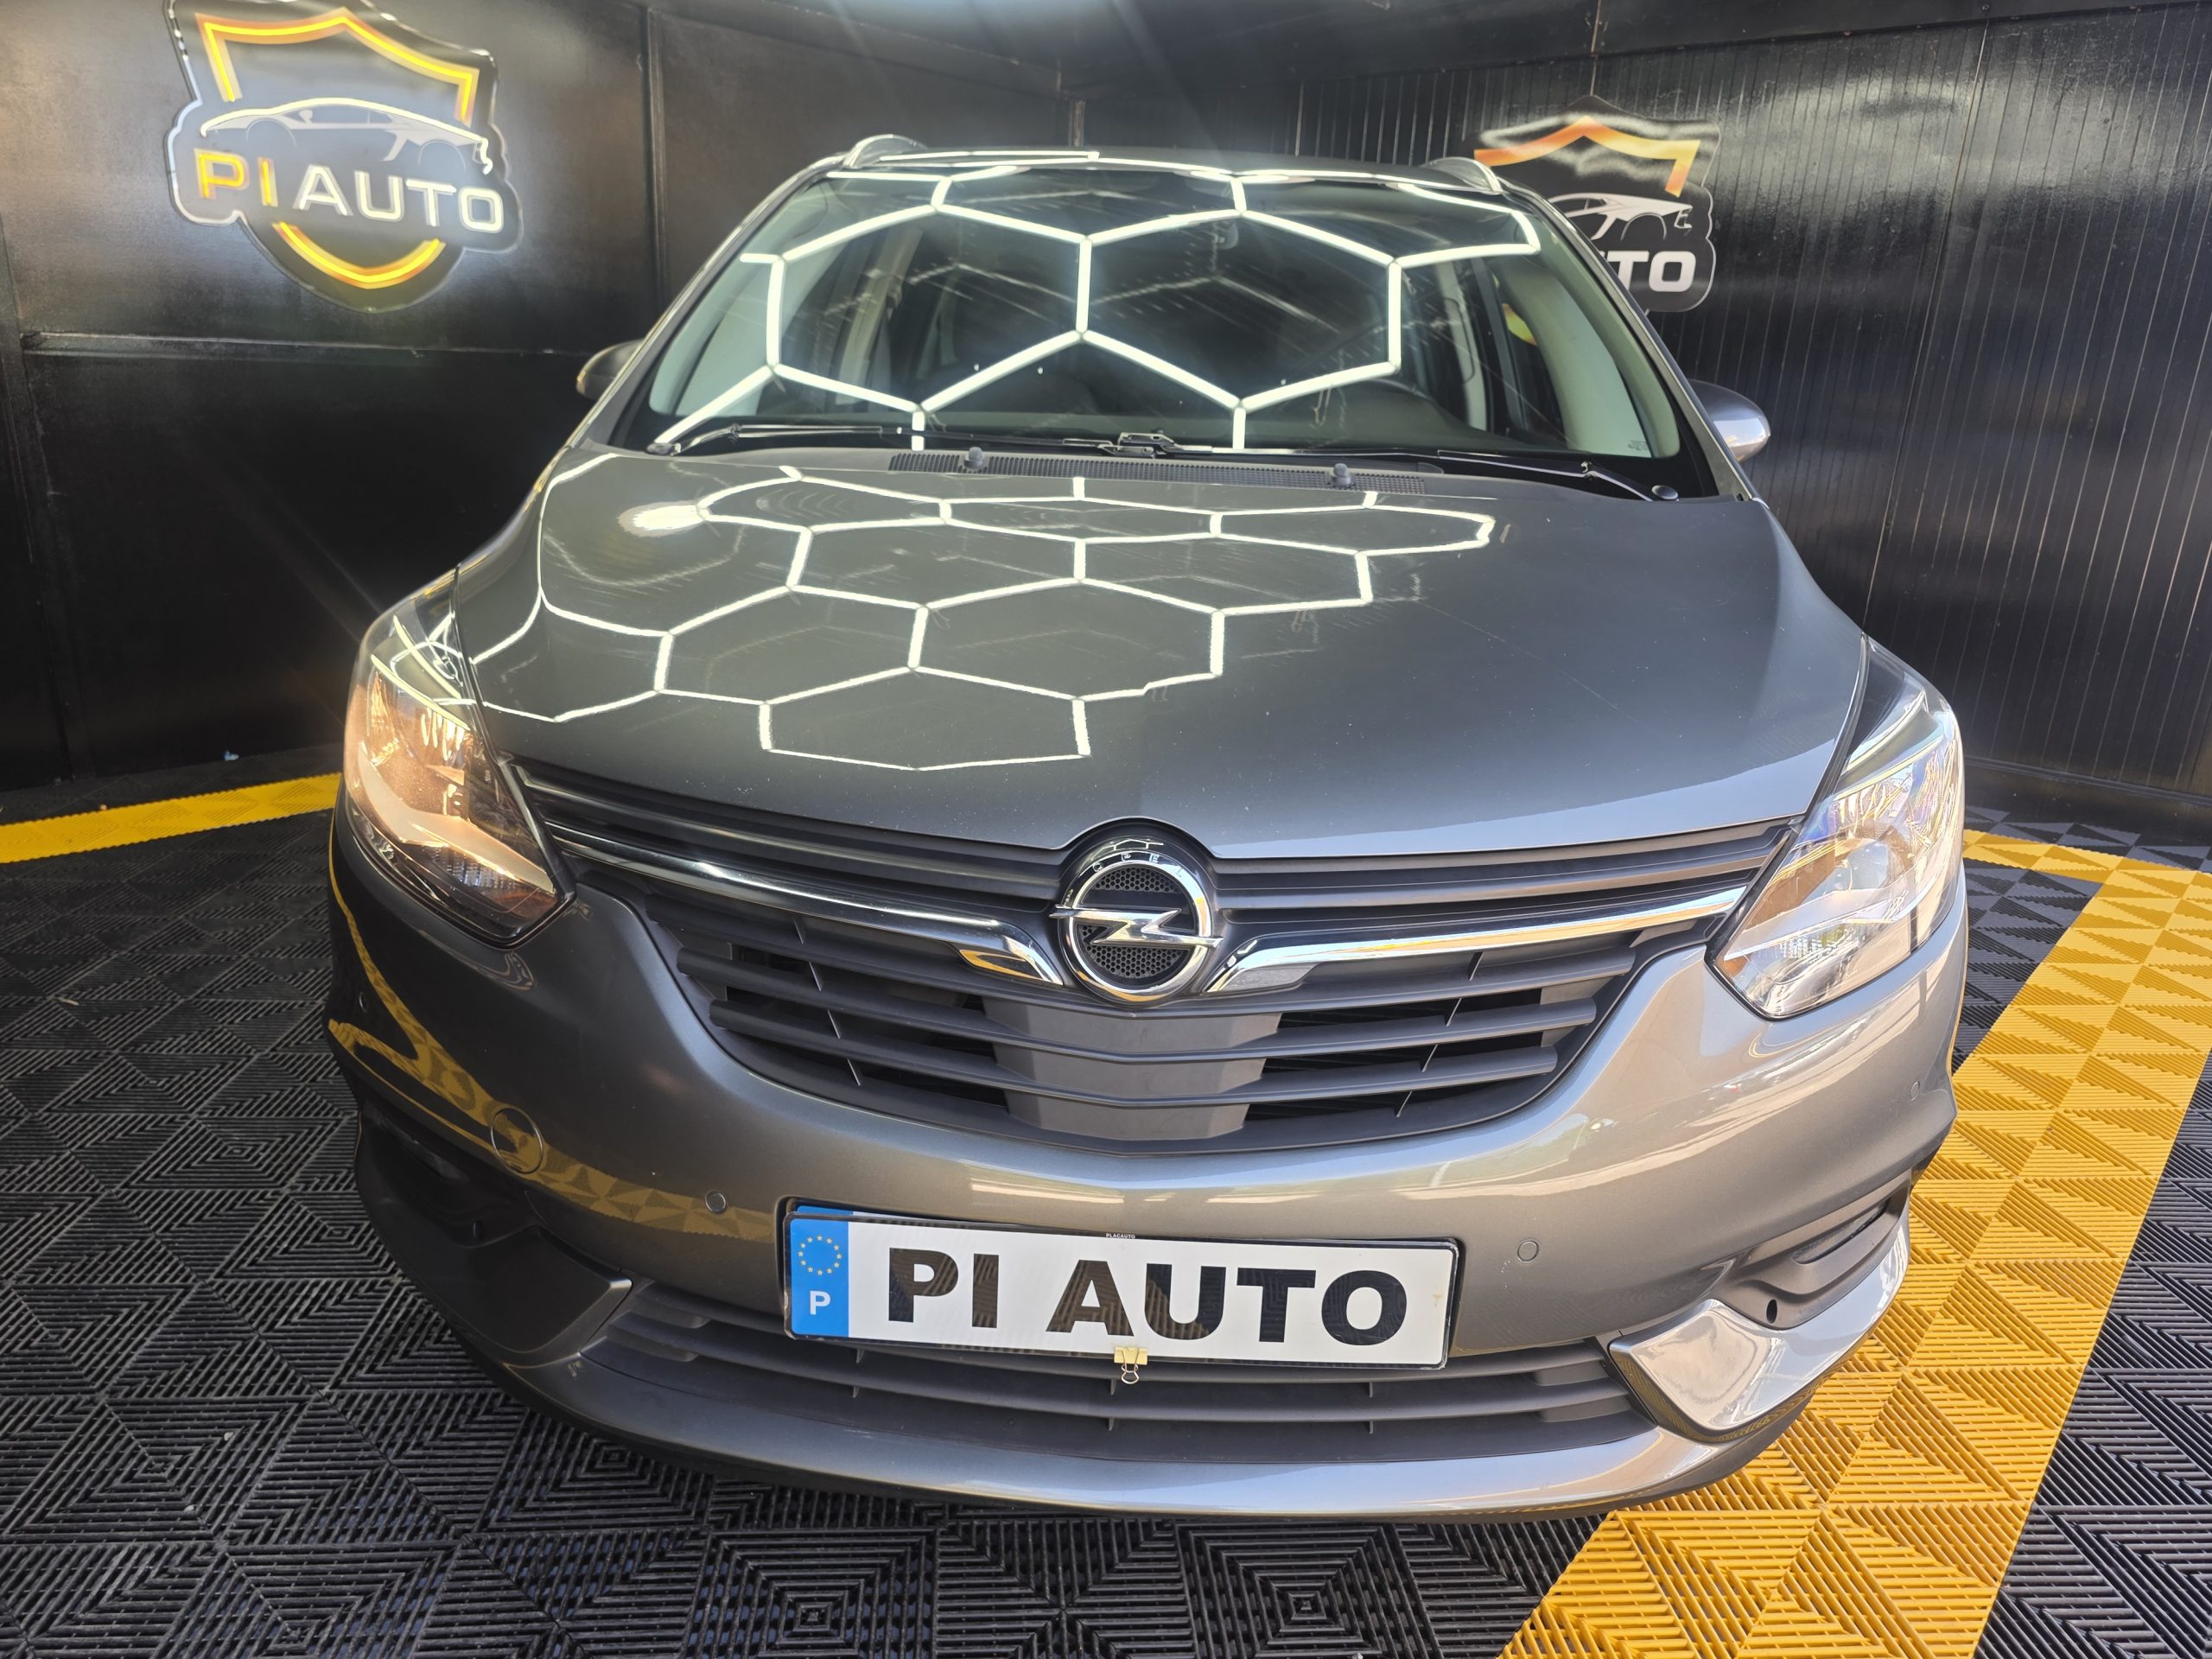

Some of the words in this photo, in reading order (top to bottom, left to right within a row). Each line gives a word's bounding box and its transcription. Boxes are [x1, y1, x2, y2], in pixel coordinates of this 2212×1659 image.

[194, 148, 278, 207] PI
[292, 164, 504, 233] AUTO
[1599, 250, 1696, 293] TO
[810, 1290, 831, 1315] P
[888, 1247, 999, 1328] PI
[1046, 1259, 1408, 1345] AUTO
